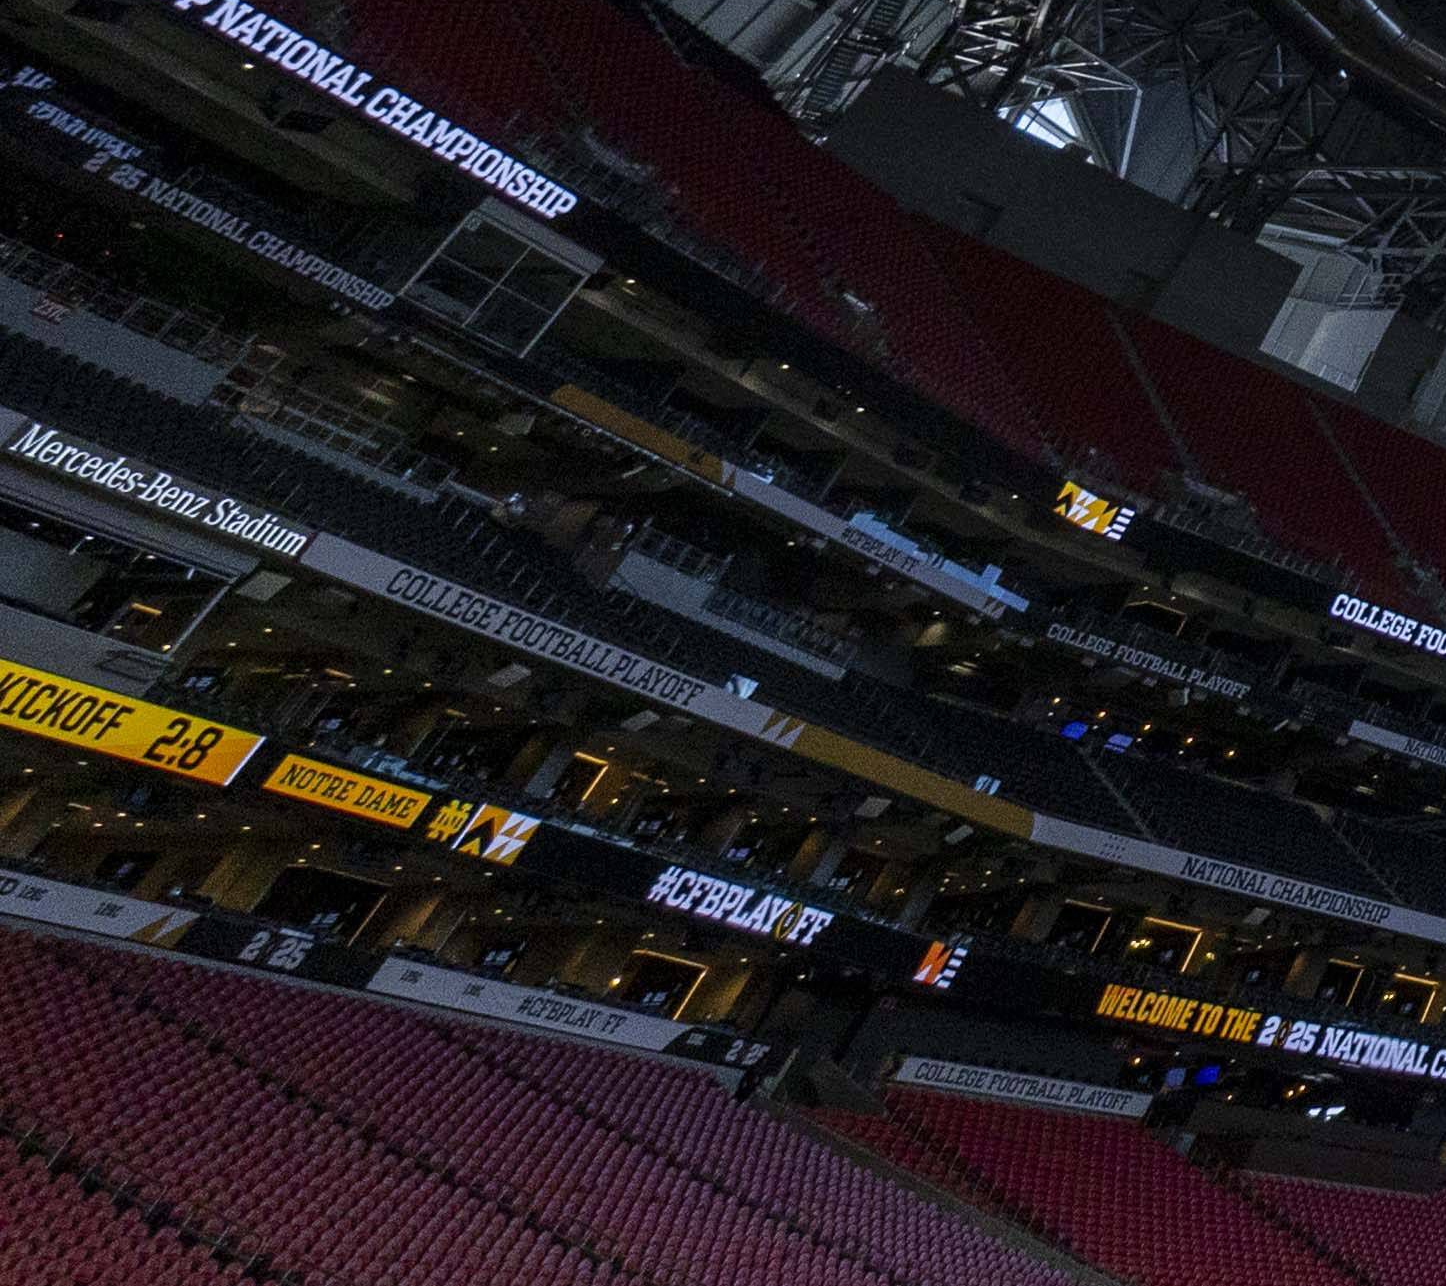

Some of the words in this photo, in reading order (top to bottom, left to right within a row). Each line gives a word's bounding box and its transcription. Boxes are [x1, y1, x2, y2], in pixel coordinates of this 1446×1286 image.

[364, 86, 578, 219] CHAMPIONSHIP
[83, 152, 148, 191] 225
[140, 178, 249, 242] NATIONAL
[249, 230, 395, 310] CHAMPIONSHIP
[9, 423, 210, 519] Mercedes-Benz
[204, 498, 308, 556] Stadium
[387, 569, 501, 632] COLLEGE
[494, 609, 613, 675] FOOTBALL
[612, 655, 705, 705] PLAYOFF
[1331, 593, 1417, 642] COLLEGE
[1047, 623, 1116, 656] COLLEGE
[1113, 644, 1188, 680] FOOTBALL
[1186, 666, 1250, 699] PLAYOFF
[279, 763, 355, 802] NOTRE
[355, 785, 418, 819] DAME
[1180, 856, 1267, 896] NATIONAL
[1267, 879, 1391, 924] CHAMPIONSHIP
[238, 929, 314, 970] 225
[516, 994, 628, 1035] #CFBPLAYFF
[1095, 982, 1199, 1033] WELCOME
[1192, 1002, 1225, 1037] TO
[1219, 1006, 1265, 1045] THE
[1315, 1026, 1431, 1076] NATIONAL
[915, 1062, 986, 1088] COLLEGE
[987, 1075, 1066, 1102] FOOTBALL
[1066, 1085, 1134, 1111] PLAYOFF
